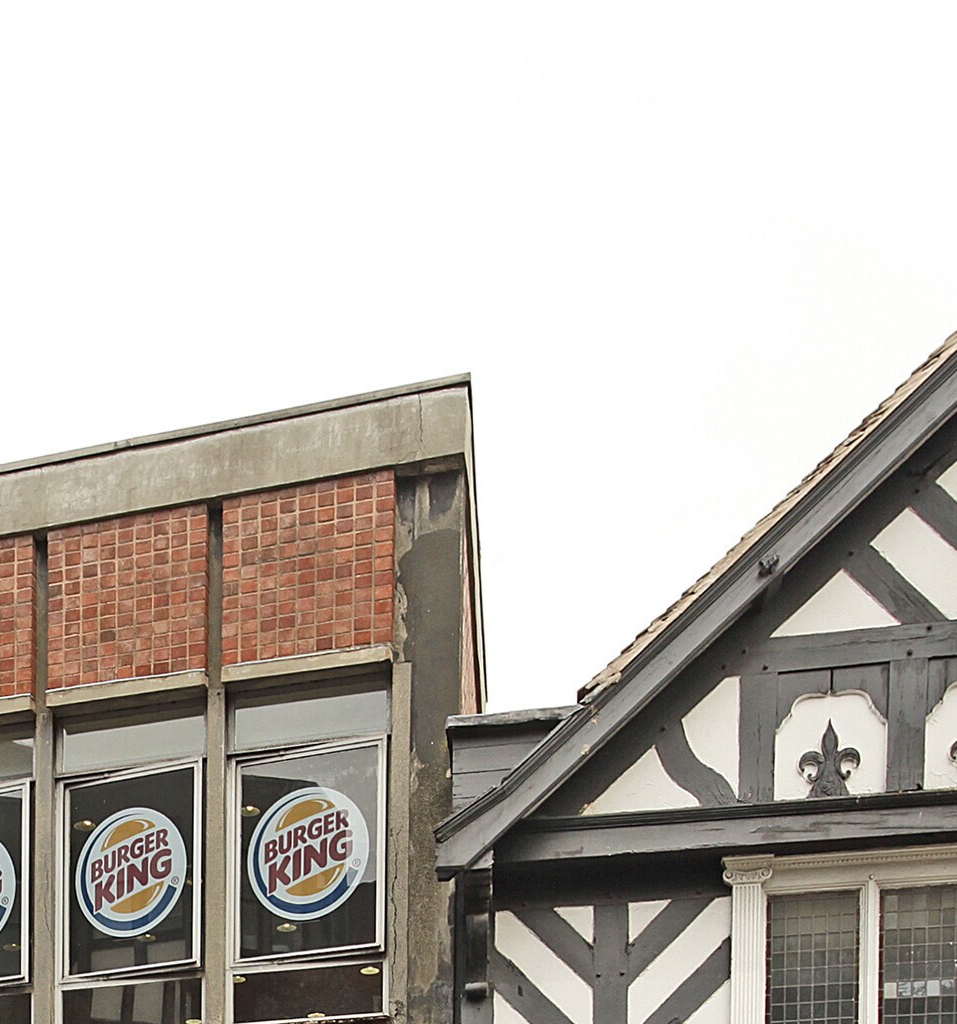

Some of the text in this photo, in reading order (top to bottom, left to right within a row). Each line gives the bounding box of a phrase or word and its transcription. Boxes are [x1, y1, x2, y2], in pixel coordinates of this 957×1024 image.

[91, 828, 169, 884] BURGER
[264, 808, 350, 865] BURGER
[268, 829, 353, 895] KING
[94, 848, 172, 913] KING
